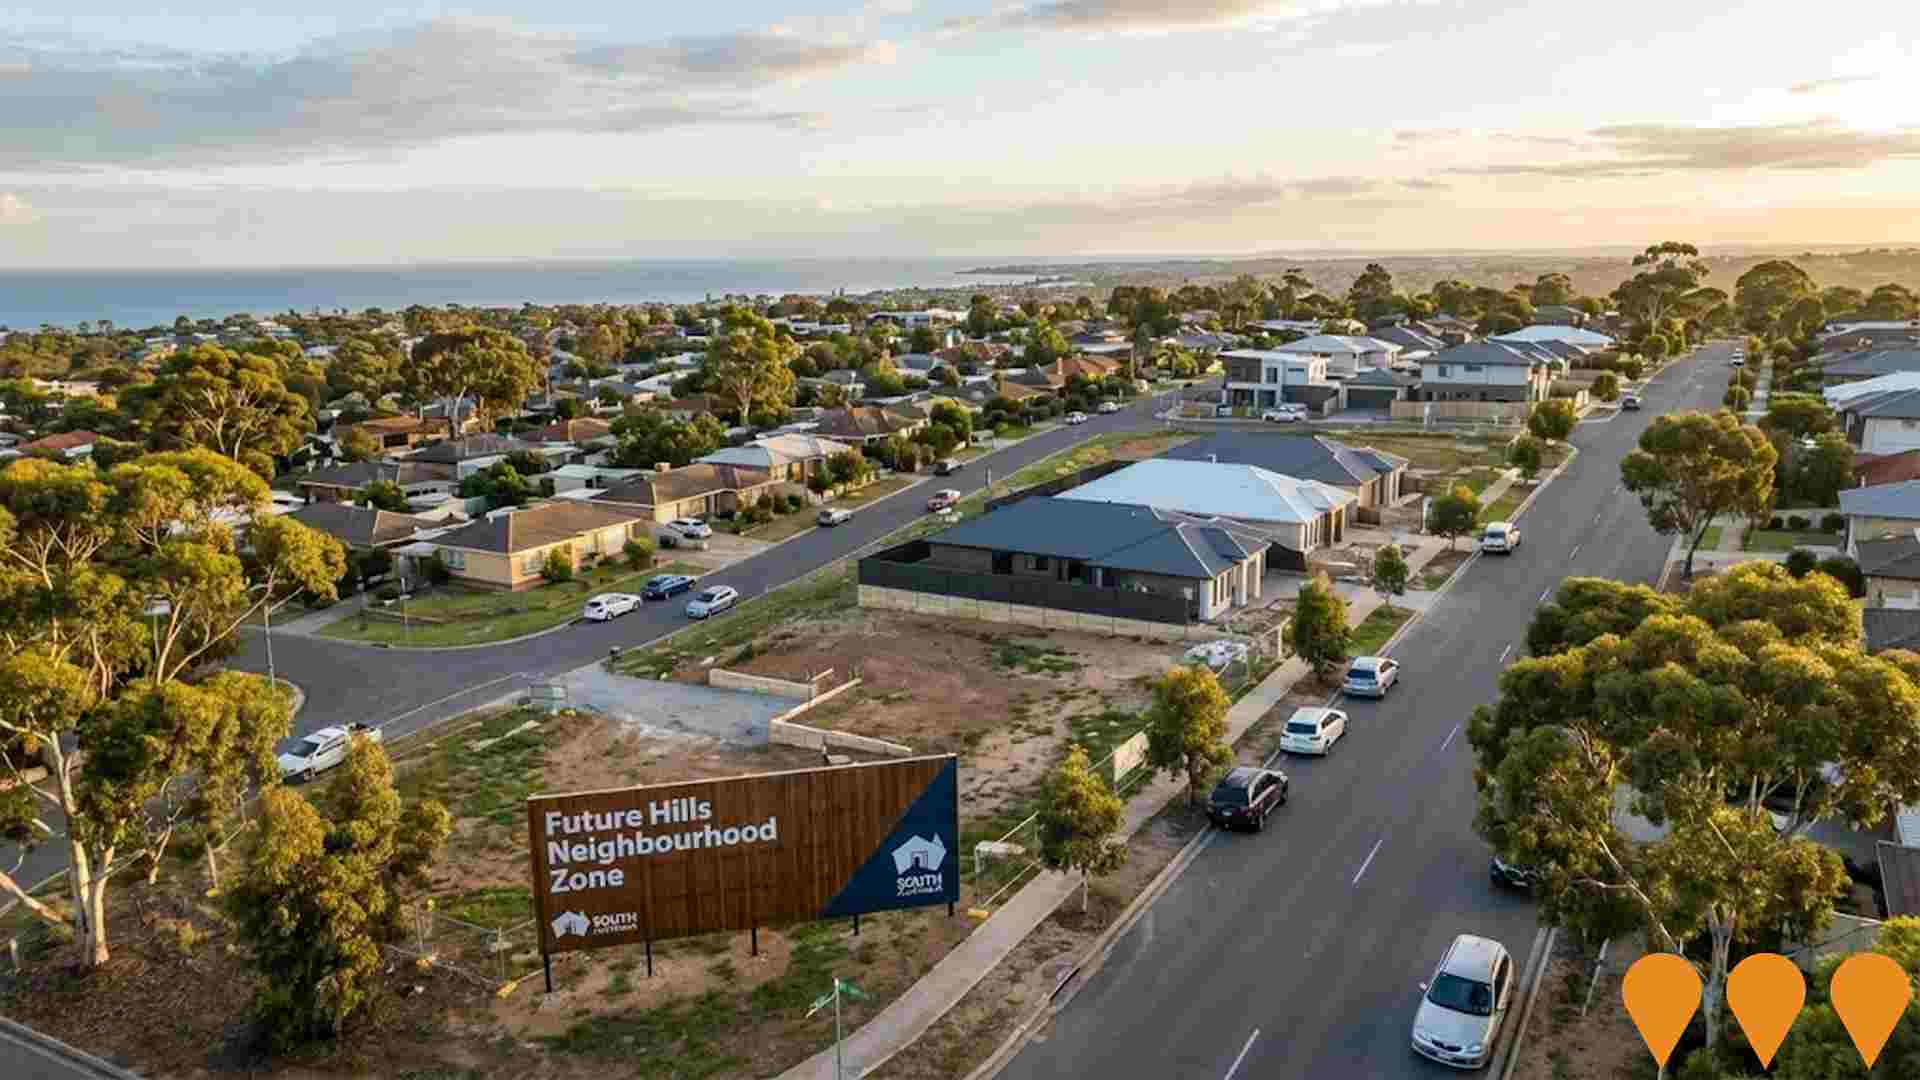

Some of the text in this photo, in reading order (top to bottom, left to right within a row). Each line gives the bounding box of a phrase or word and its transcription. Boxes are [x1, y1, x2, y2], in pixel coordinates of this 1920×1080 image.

[544, 796, 712, 835] Future Hills
[547, 816, 777, 864] Neighbourhood
[550, 868, 625, 893] Zone
